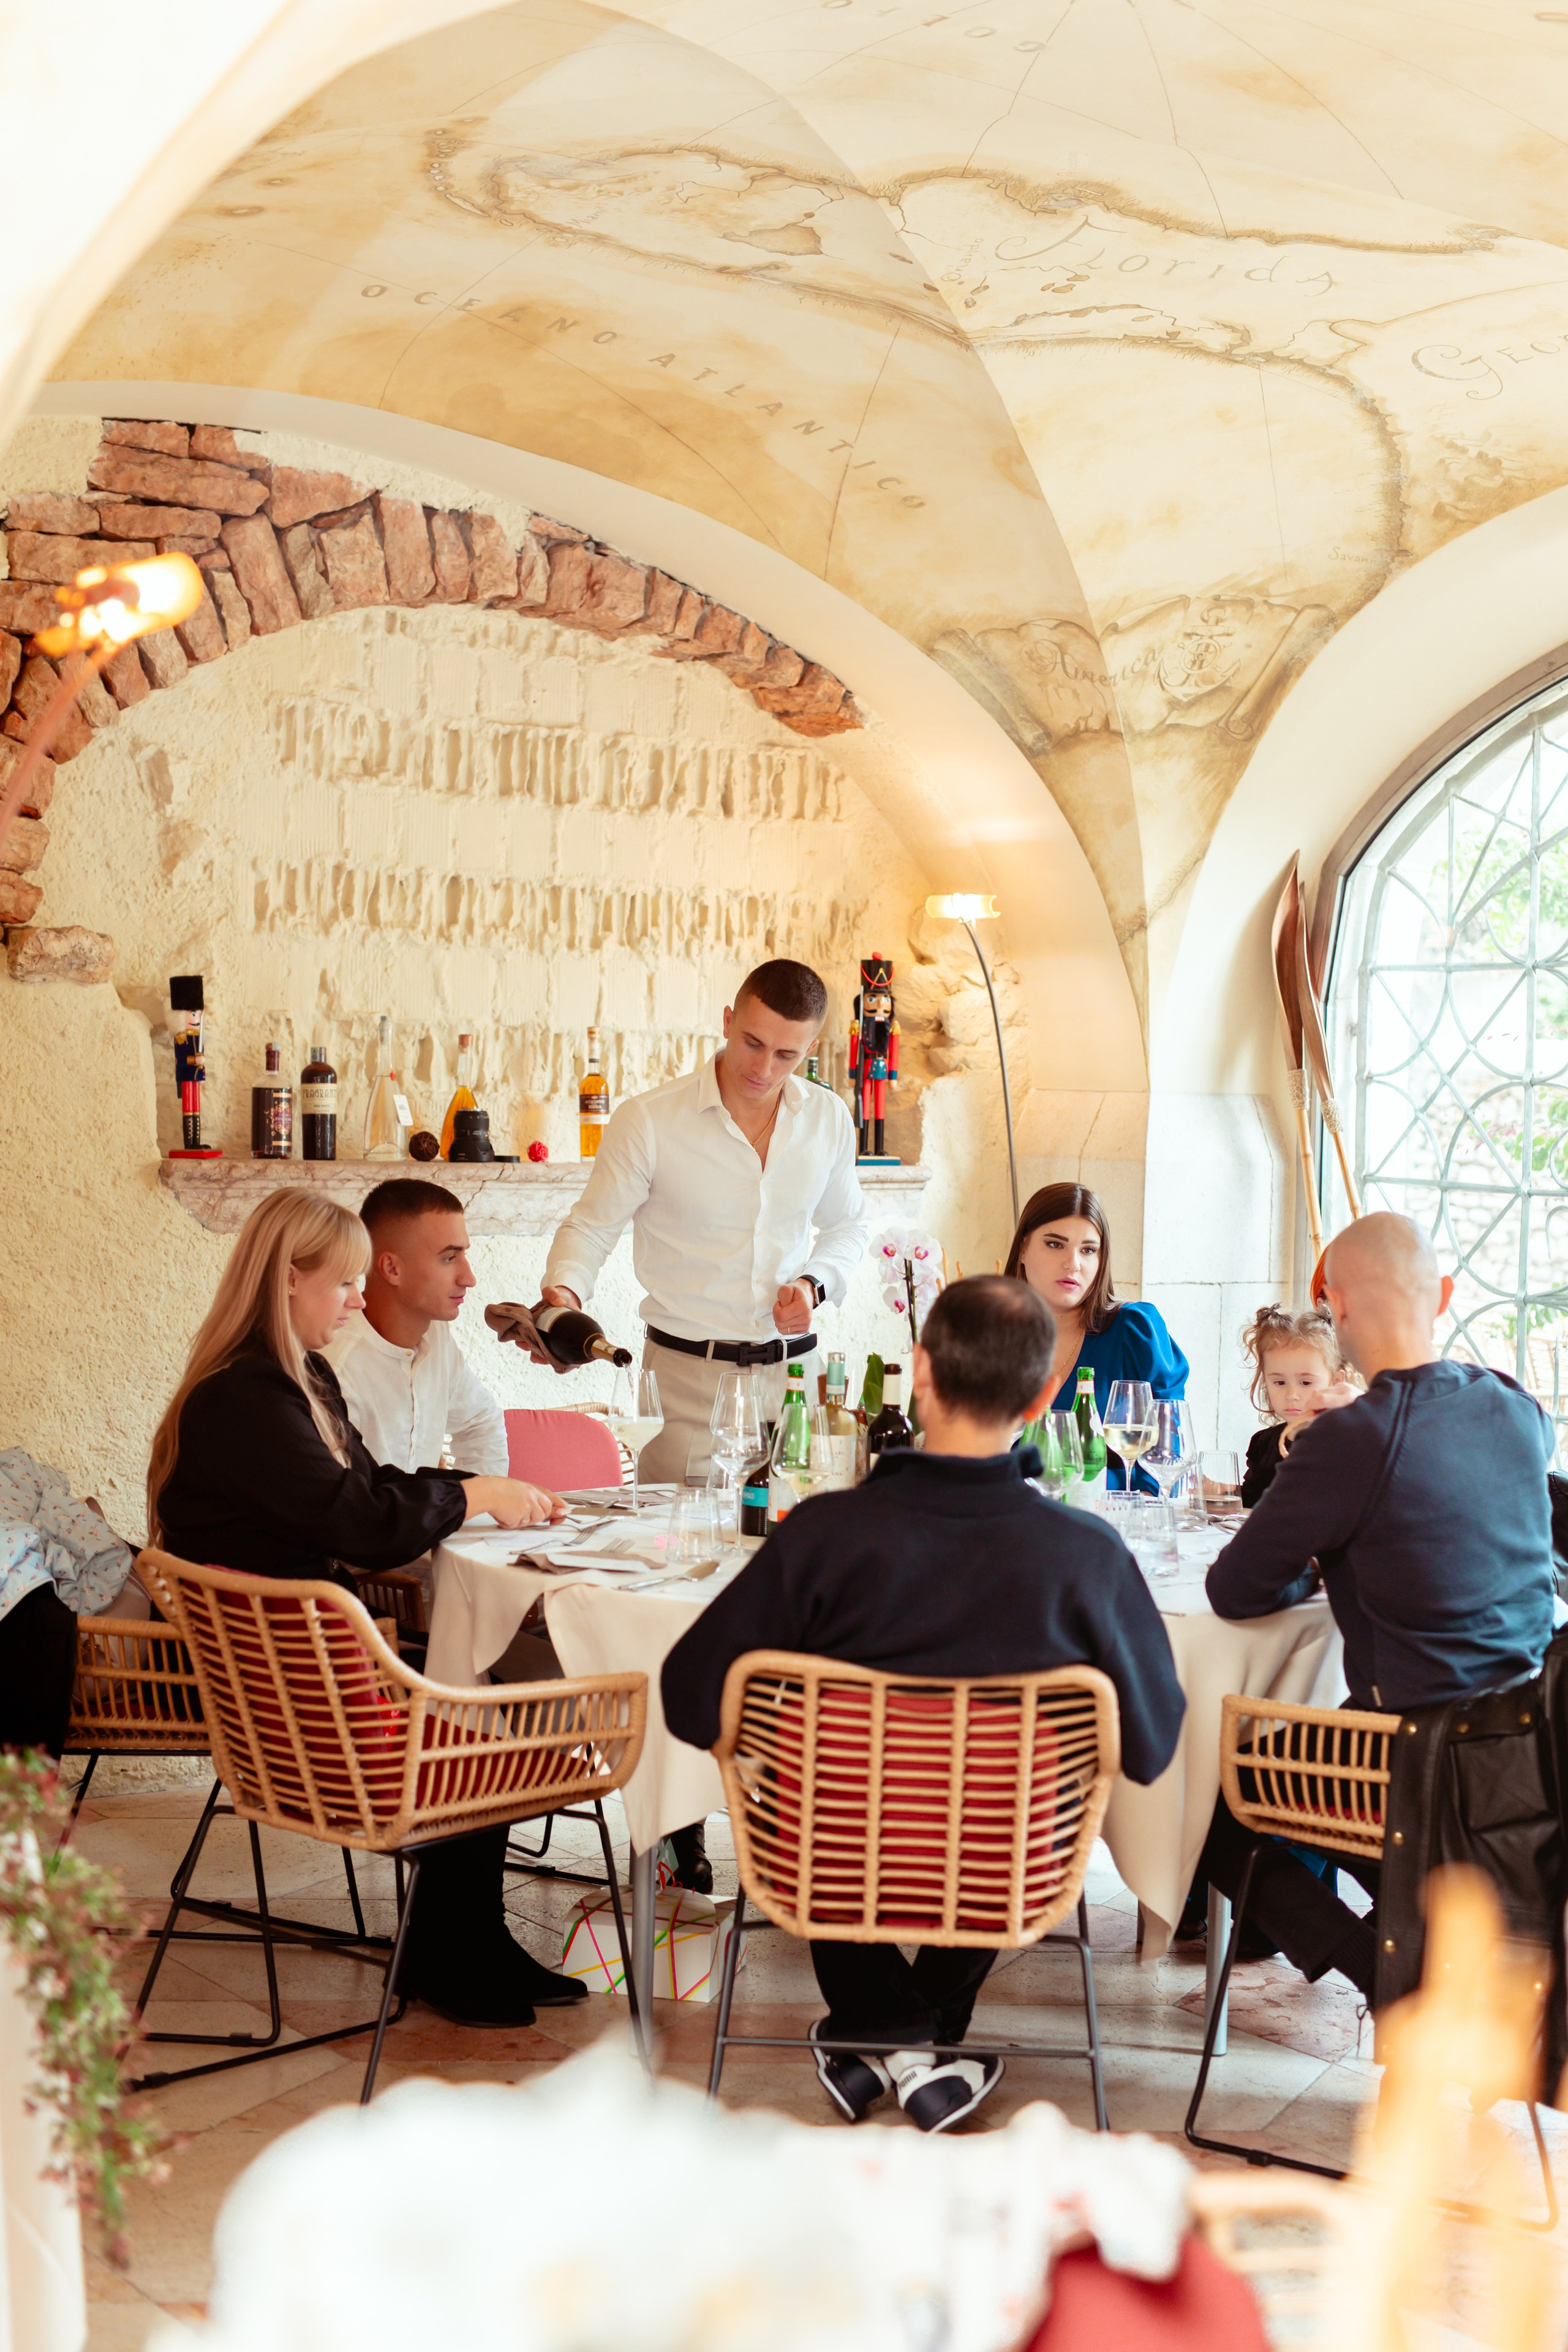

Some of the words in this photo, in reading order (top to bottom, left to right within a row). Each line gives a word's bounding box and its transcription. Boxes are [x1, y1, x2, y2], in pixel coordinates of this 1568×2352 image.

[940, 238, 984, 282] Orlando
[360, 284, 617, 344] OCEANO
[647, 352, 927, 510] ATLANTICO
[898, 2071, 918, 2090] PUMA
